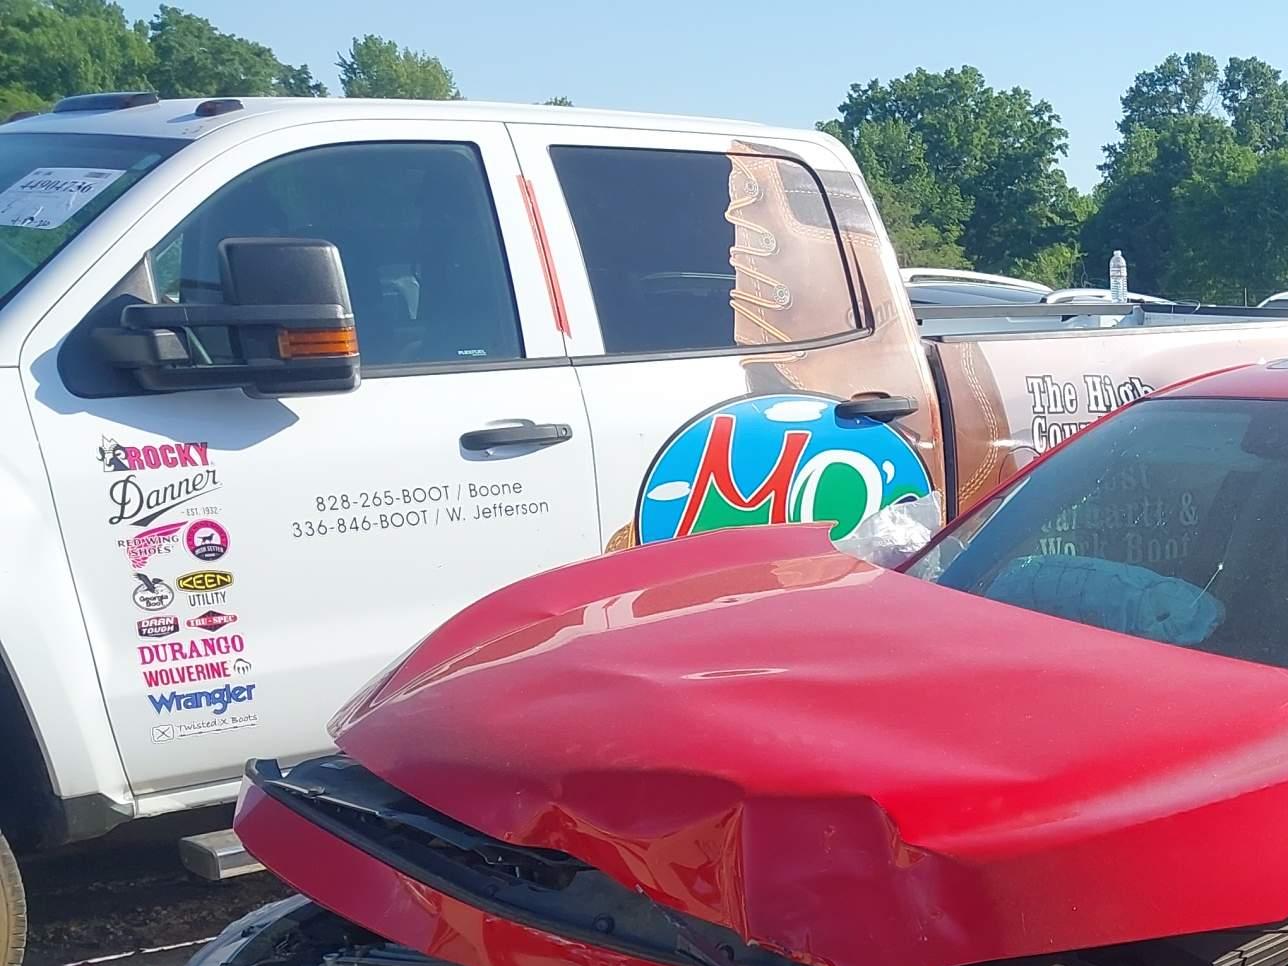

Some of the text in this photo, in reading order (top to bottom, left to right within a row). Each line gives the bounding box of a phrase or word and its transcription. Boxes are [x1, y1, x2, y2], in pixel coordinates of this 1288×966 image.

[1026, 375, 1078, 414] The
[125, 442, 210, 471] ROCKY
[109, 469, 219, 525] Danner
[315, 482, 523, 512] 828-265-BOOT / Boone
[1179, 491, 1199, 526] &
[292, 501, 549, 538] 336-846-BOOT / W. Jefferson
[117, 535, 179, 548] RED WING
[130, 546, 171, 556] SHOES
[179, 573, 232, 590] KEEN
[188, 591, 227, 607] UTILITY
[142, 626, 175, 634] TOUGH
[138, 634, 245, 665] DURANGO
[143, 661, 232, 688] WOLVERINE
[148, 684, 256, 715] Wrangler
[178, 717, 217, 733] Twisted
[231, 714, 258, 726] Boots
